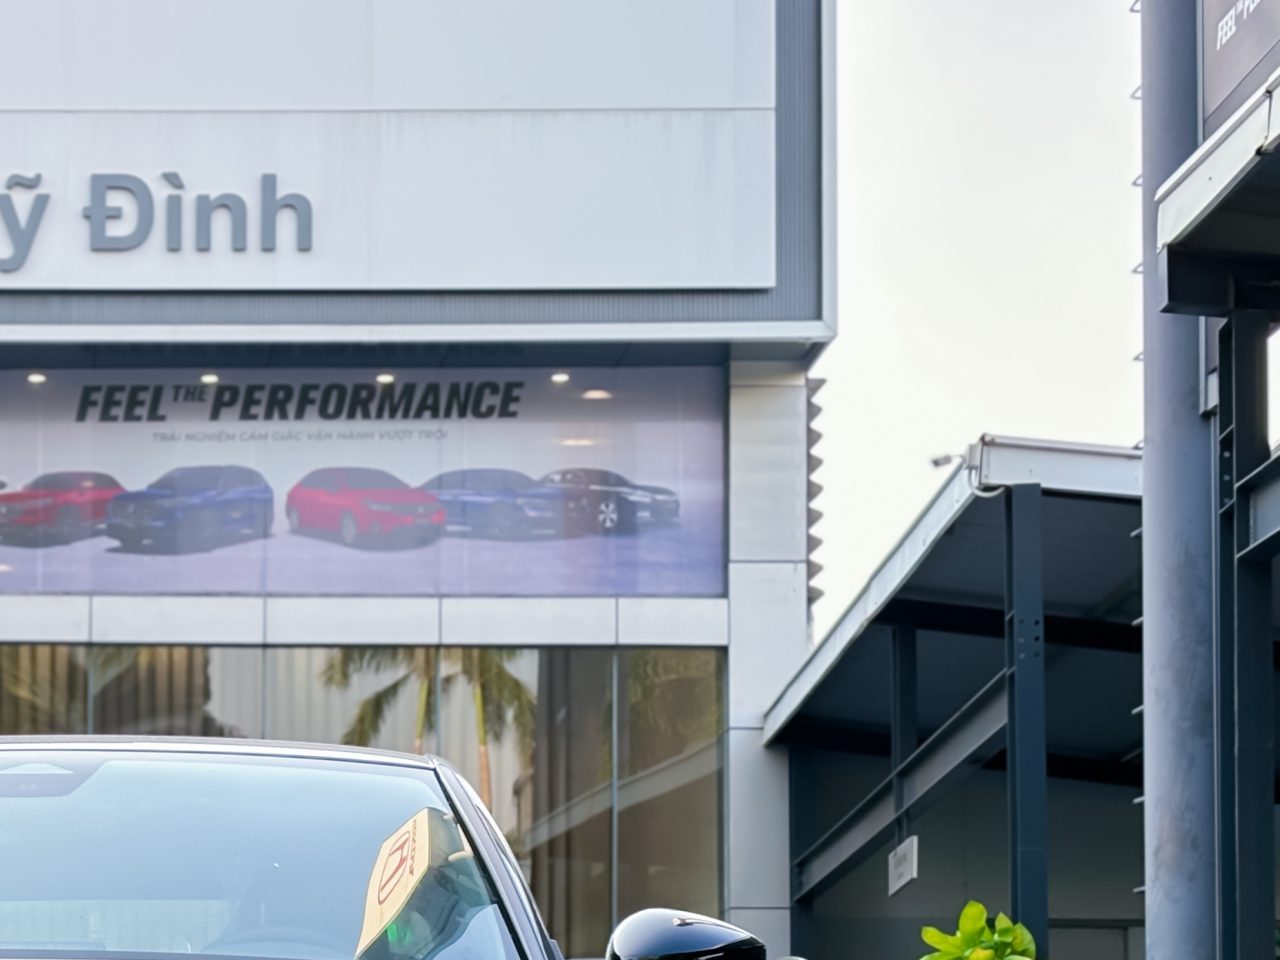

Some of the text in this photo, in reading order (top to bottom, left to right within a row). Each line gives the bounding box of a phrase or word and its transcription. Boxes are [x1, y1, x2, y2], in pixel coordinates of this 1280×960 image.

[82, 172, 314, 253] Đình
[75, 381, 525, 422] FEEL THE PERFORMANCE
